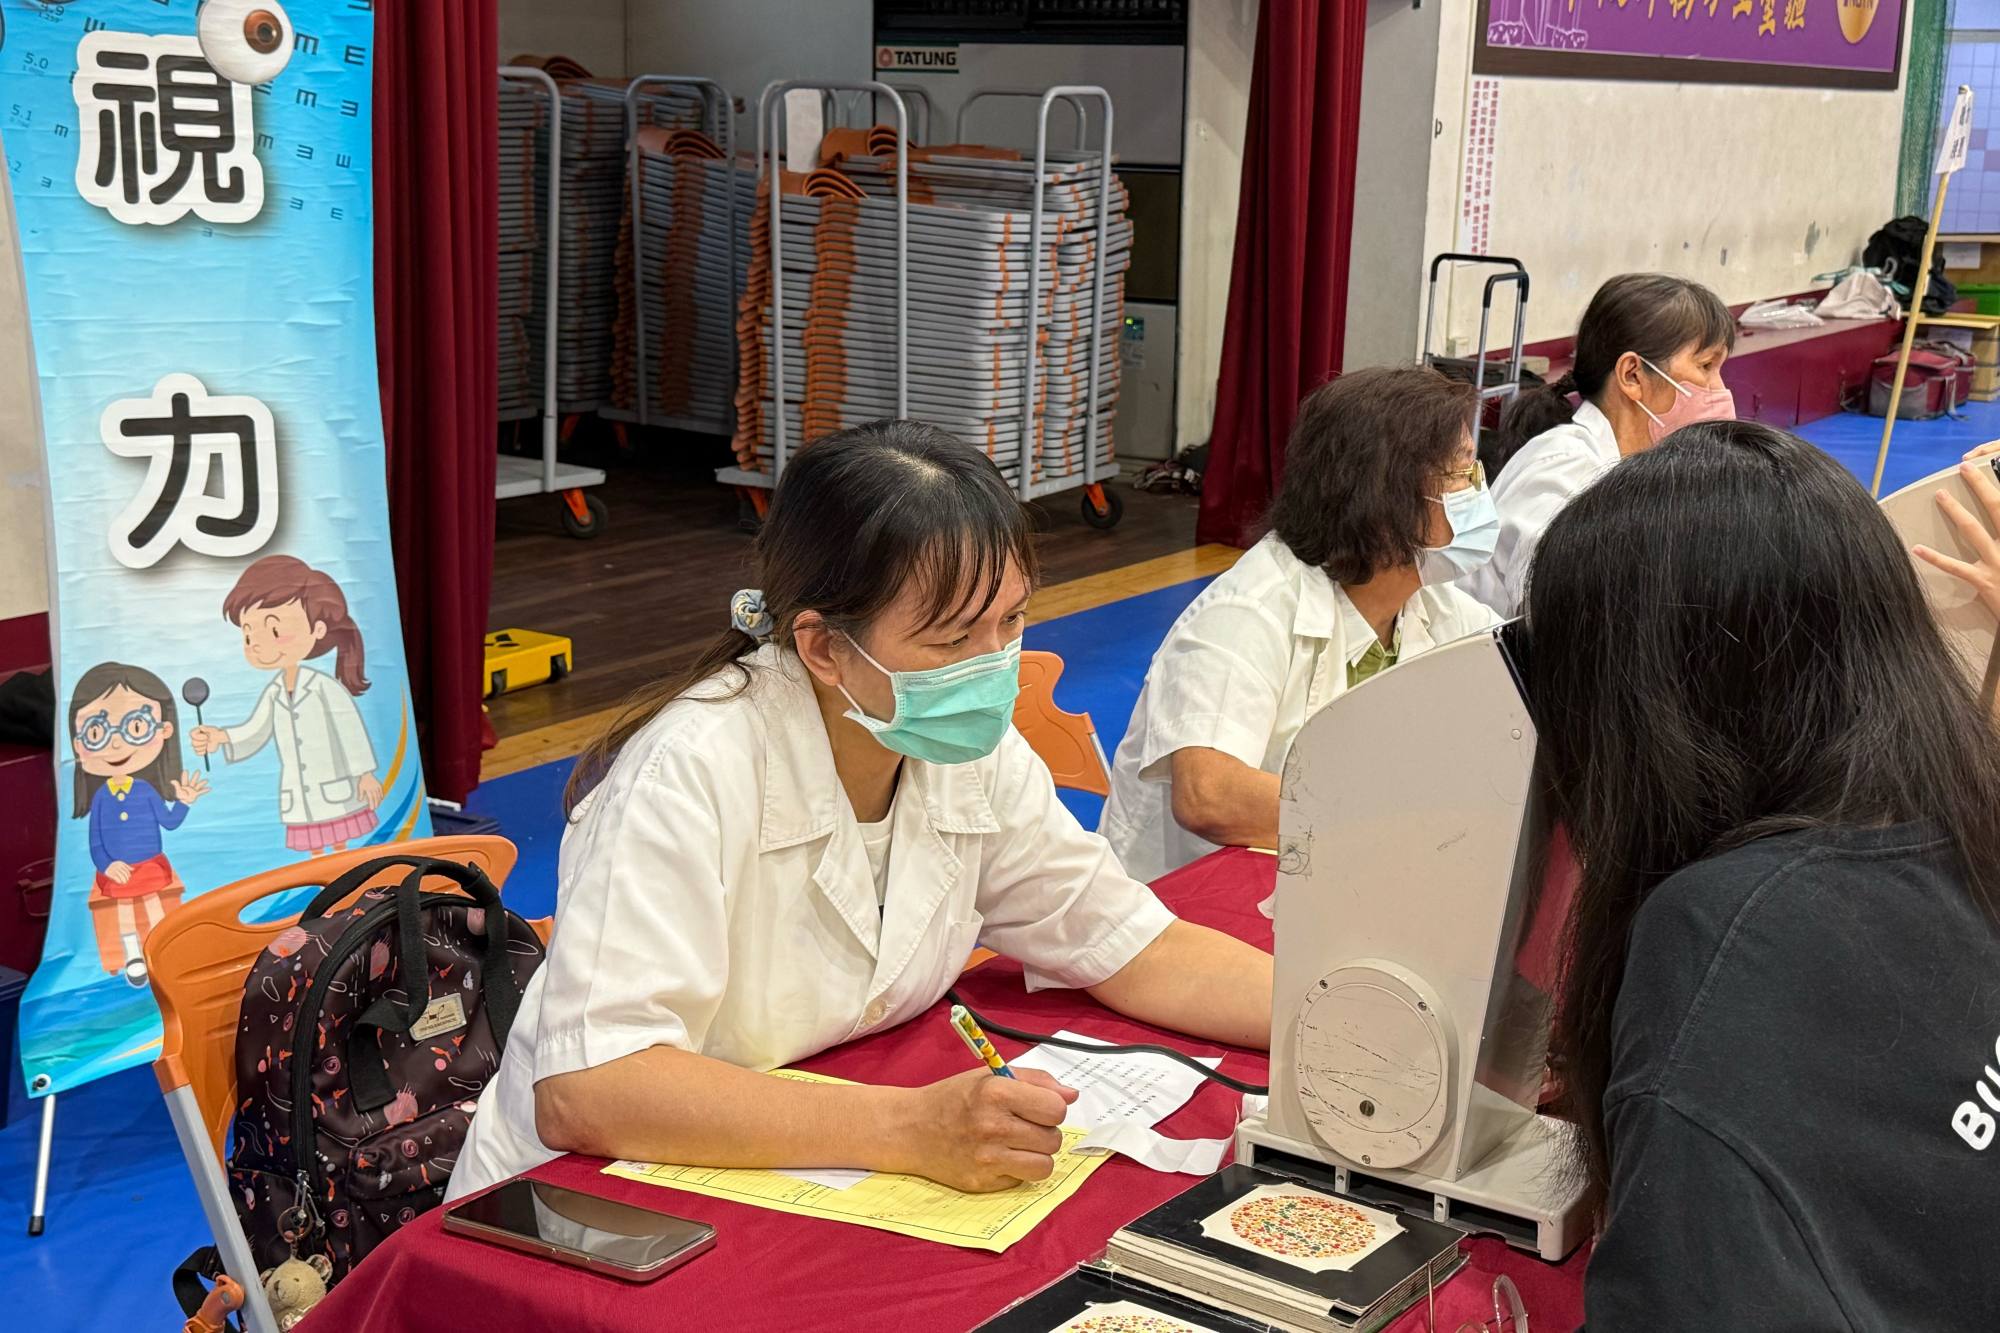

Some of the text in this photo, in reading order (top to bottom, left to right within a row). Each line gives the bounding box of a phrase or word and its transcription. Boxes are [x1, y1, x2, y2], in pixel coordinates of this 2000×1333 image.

[24, 52, 49, 69] 5.0
[895, 51, 957, 66] TATUNG
[11, 103, 33, 121] 5.1
